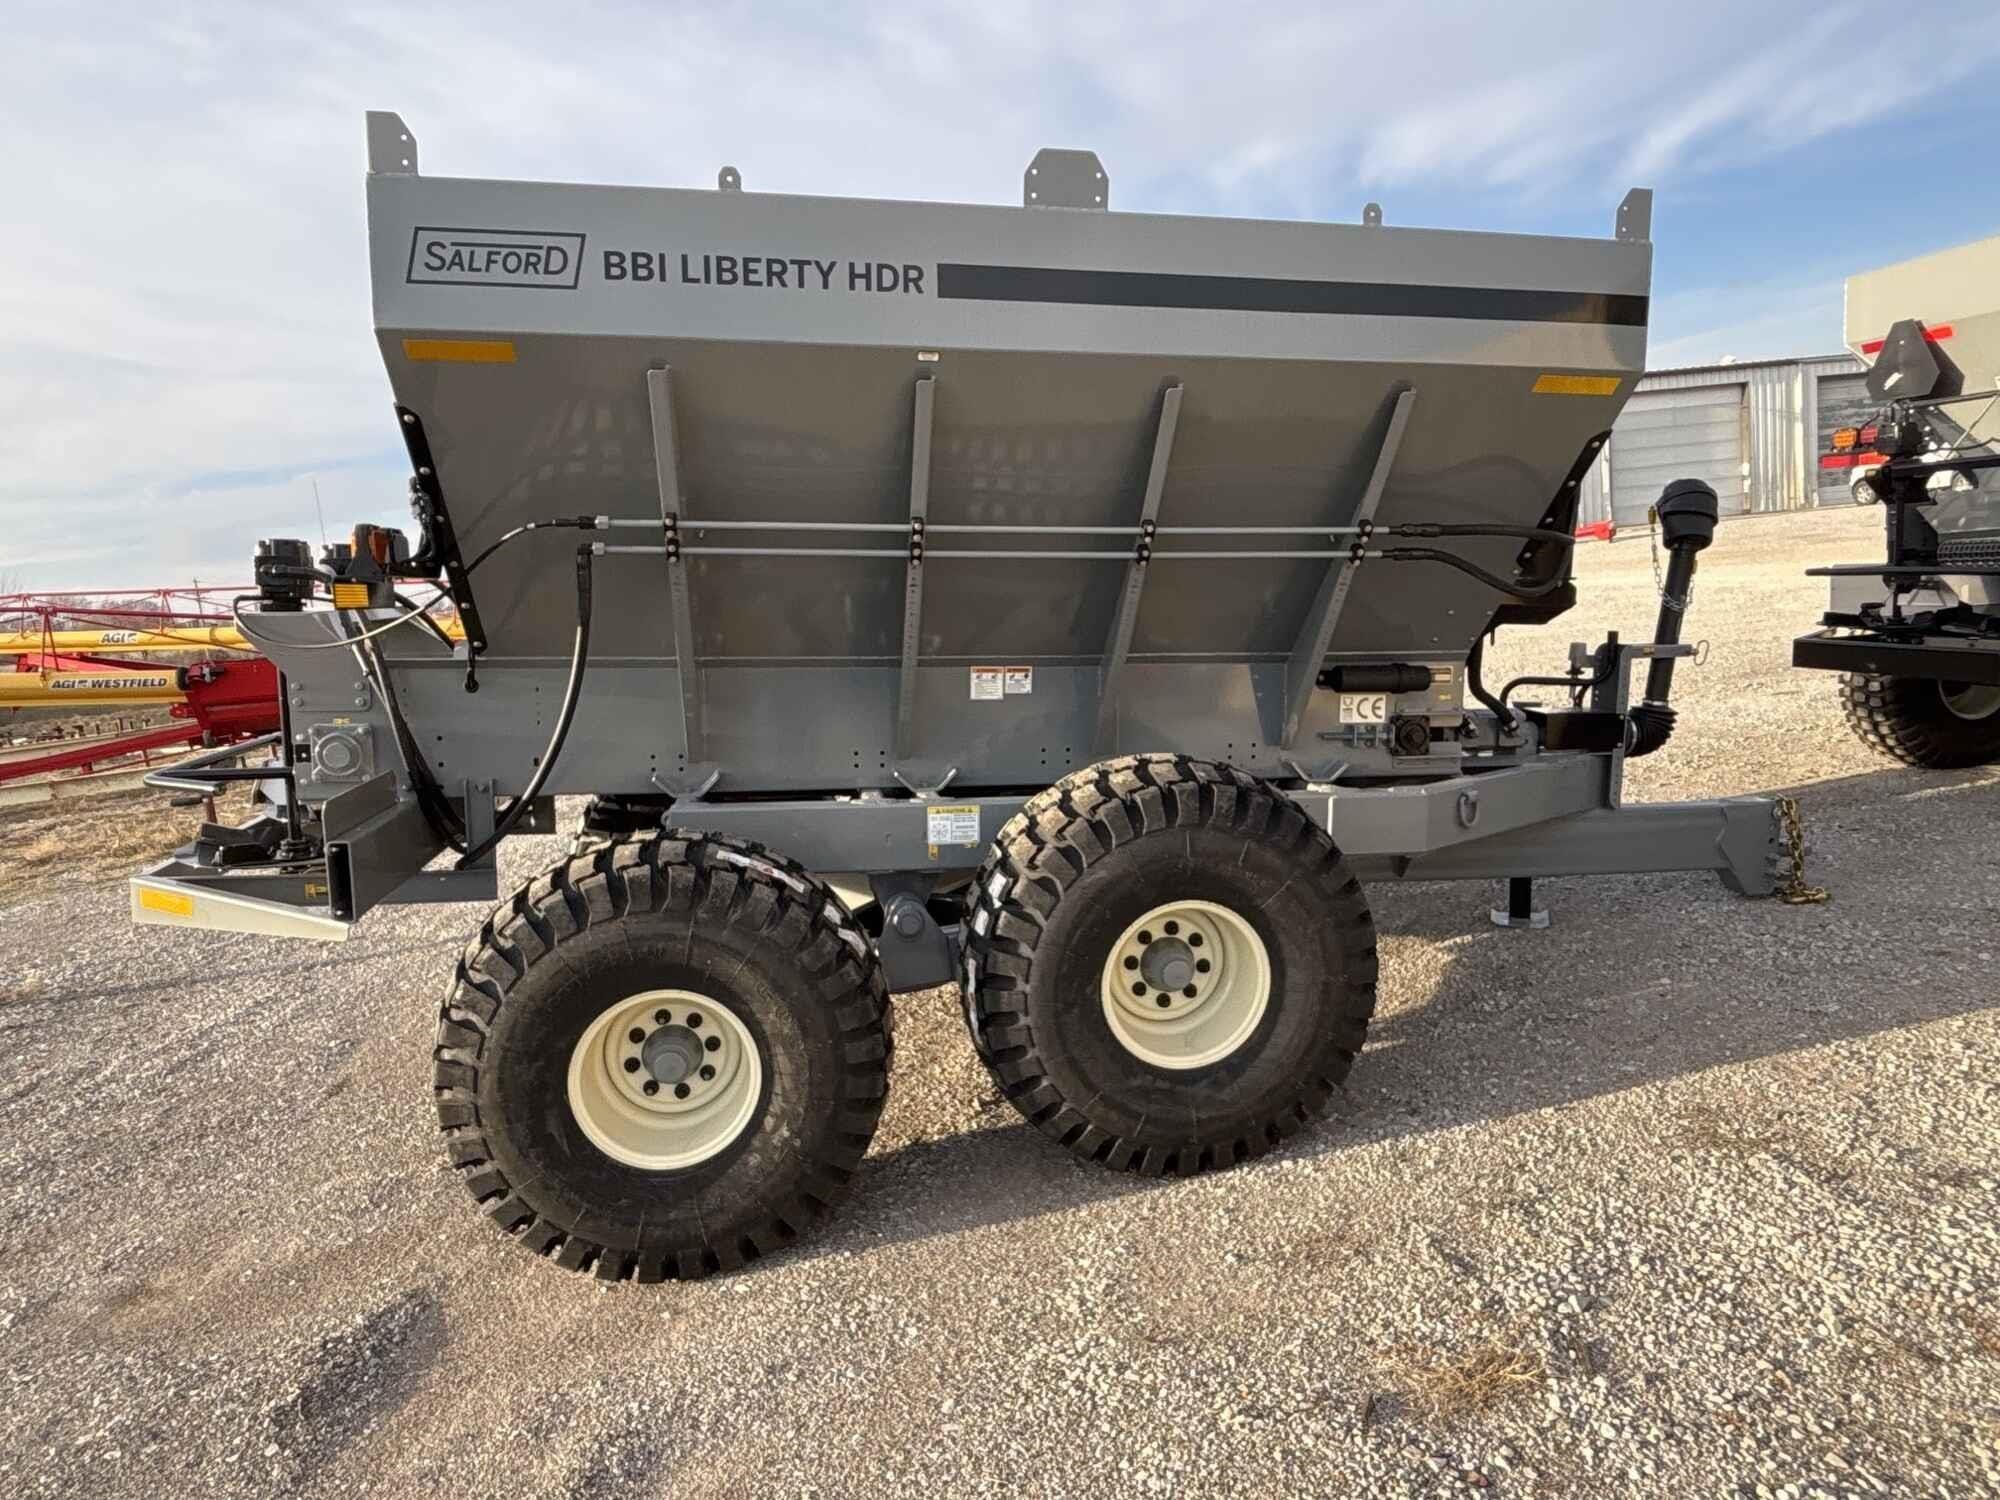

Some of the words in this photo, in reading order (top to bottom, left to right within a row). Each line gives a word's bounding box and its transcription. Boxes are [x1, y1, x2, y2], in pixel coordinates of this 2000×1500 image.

[424, 240, 569, 275] SALFORD
[603, 250, 666, 283] BBI
[681, 253, 837, 290] LIBERTY
[848, 261, 925, 294] HDR
[101, 633, 125, 643] AGI
[52, 680, 76, 689] AGI
[91, 679, 168, 688] WESTFIELD
[1356, 697, 1384, 719] CE
